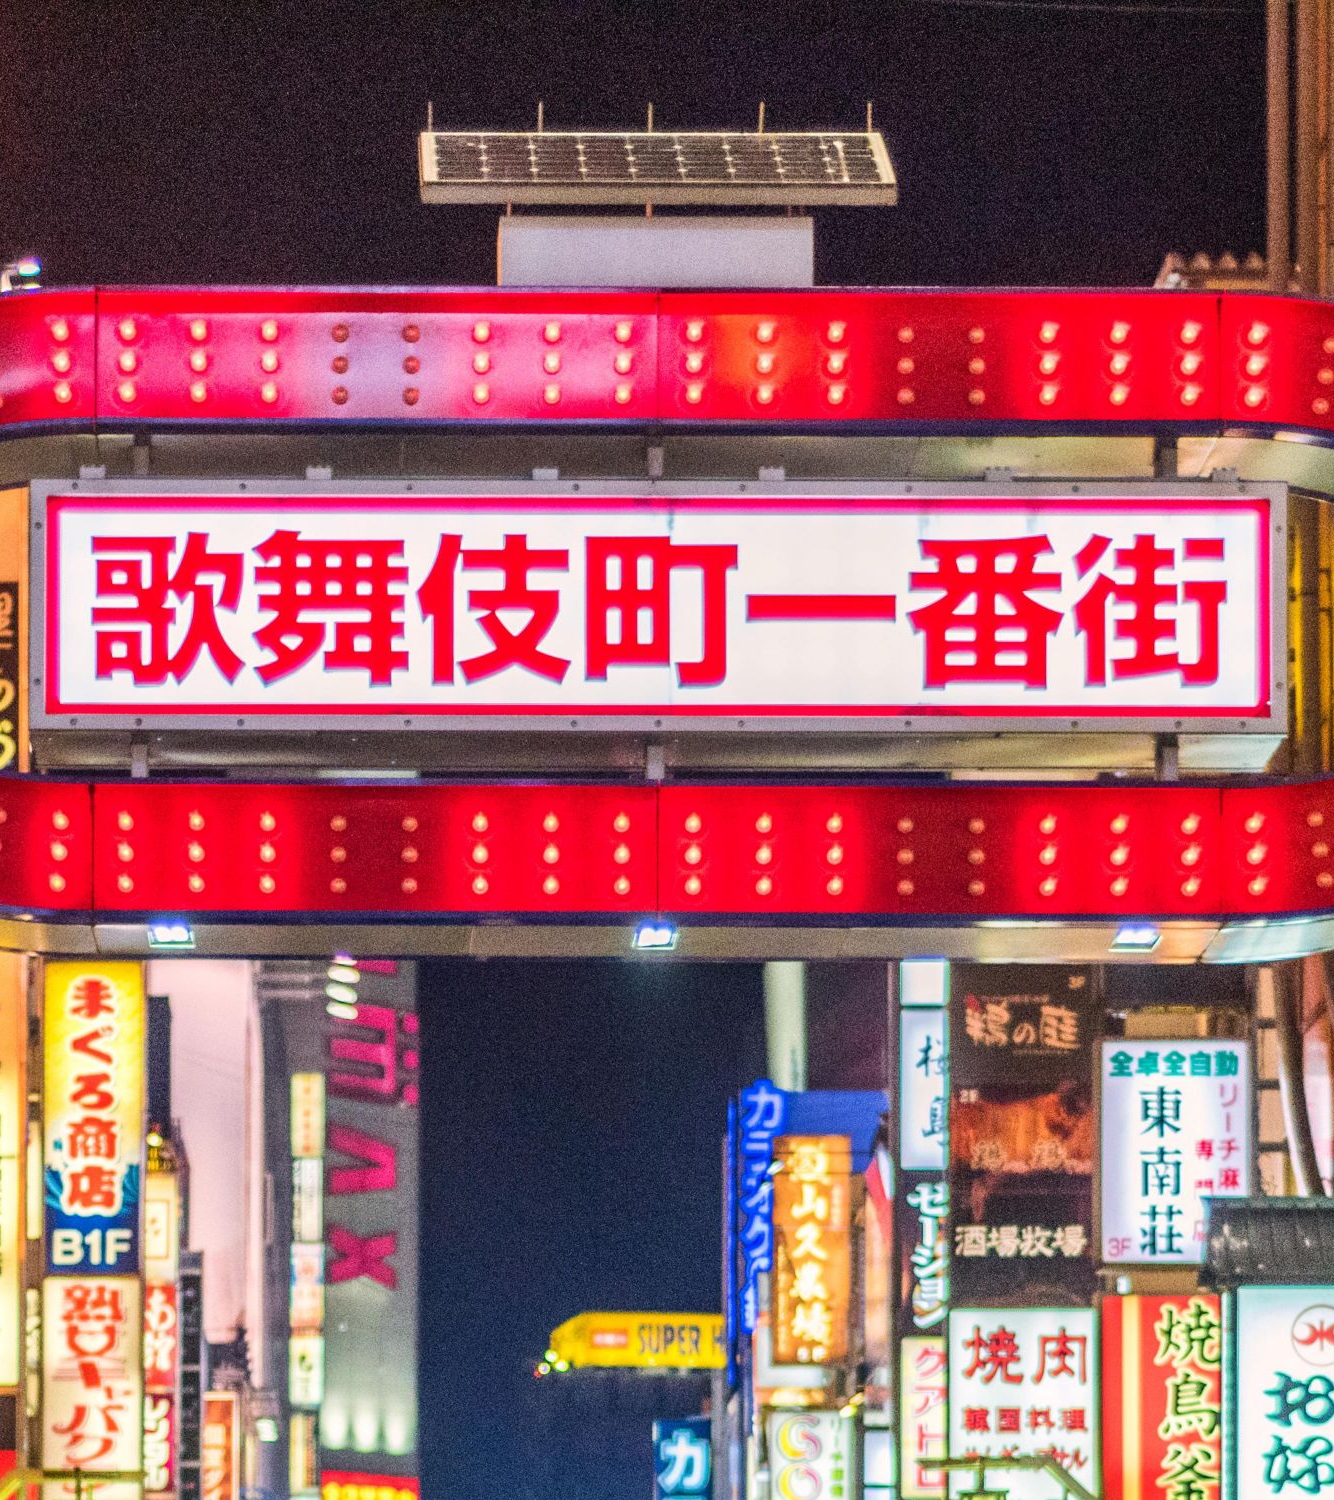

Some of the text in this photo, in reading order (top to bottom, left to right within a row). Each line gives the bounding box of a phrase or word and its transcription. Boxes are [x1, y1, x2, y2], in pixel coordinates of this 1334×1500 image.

[91, 529, 1227, 690] 歌舞伎町一番街
[1108, 1050, 1239, 1078] 全卓全自動
[67, 976, 121, 1216] まぐろ商店
[1139, 1086, 1184, 1256] 東南荘
[52, 1229, 132, 1267] B1F
[955, 1224, 1088, 1258] 酒場牧場
[1107, 1238, 1132, 1257] 3F
[637, 1323, 701, 1355] SUPER
[961, 1324, 1089, 1385] 焼肉
